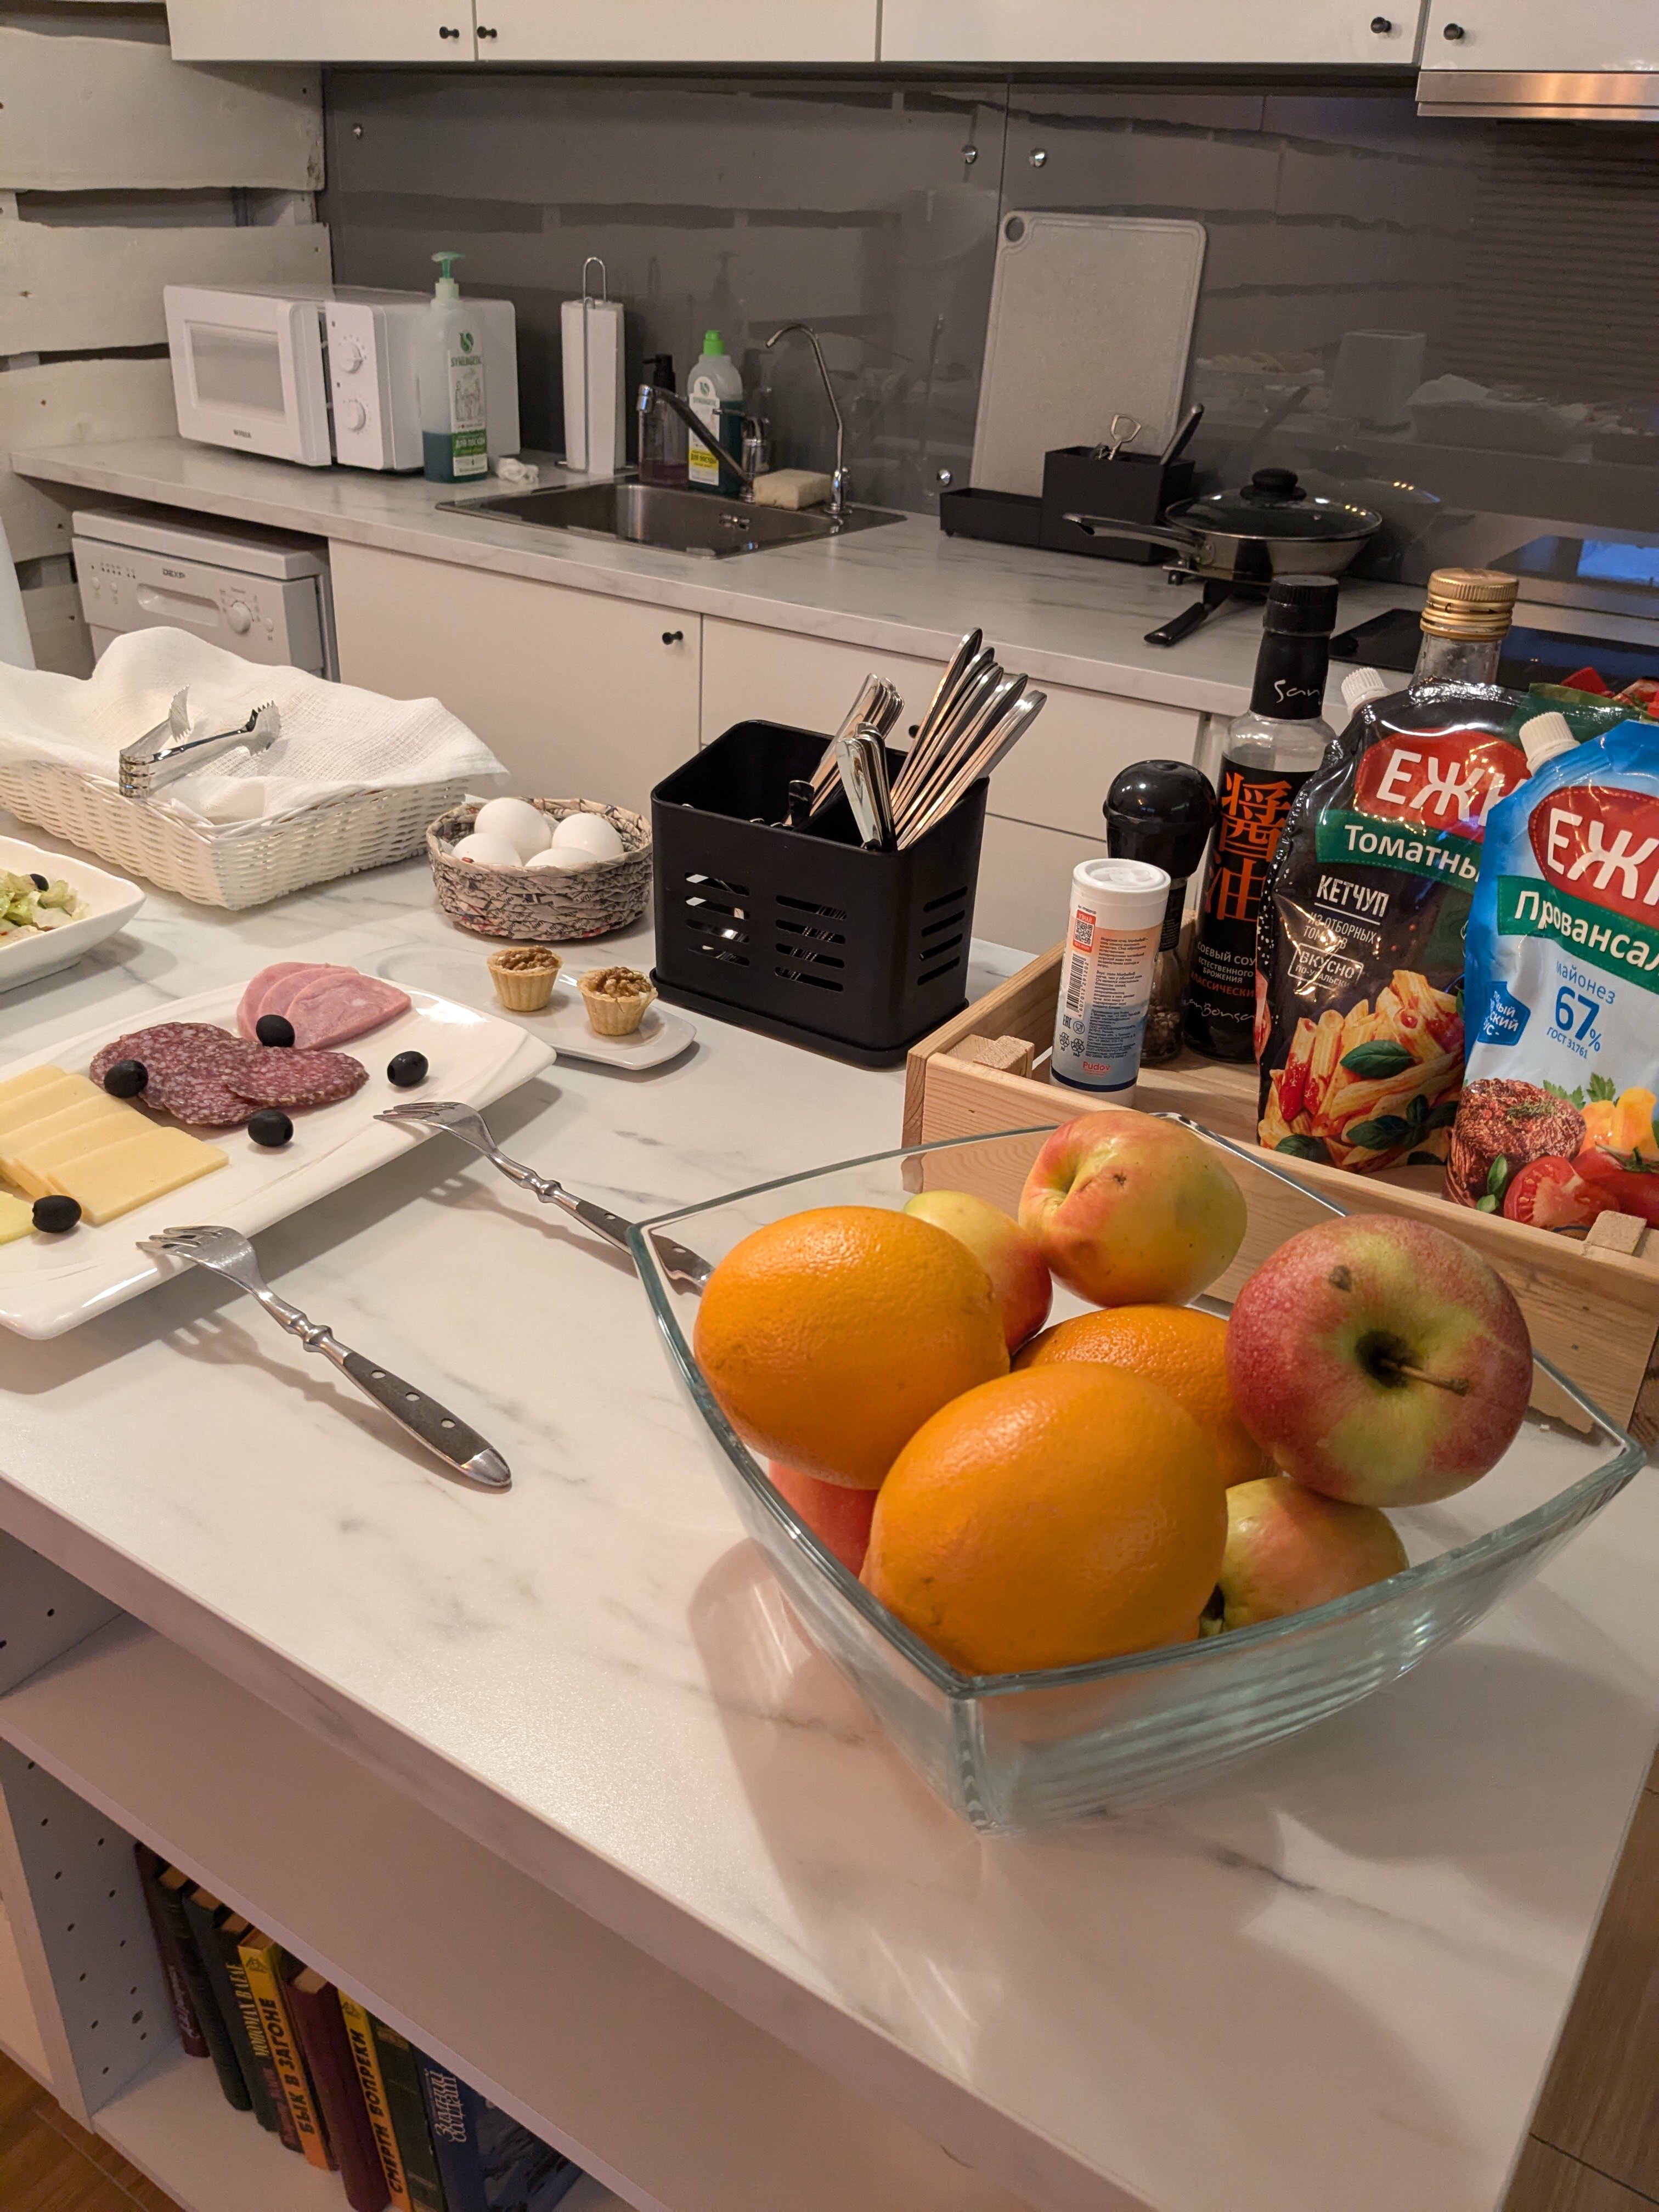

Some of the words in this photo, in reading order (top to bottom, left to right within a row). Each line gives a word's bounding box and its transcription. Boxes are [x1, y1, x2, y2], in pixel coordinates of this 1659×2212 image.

[1274, 679, 1322, 704] San
[1344, 825, 1480, 882] Томатны
[1317, 874, 1390, 917] КЕТЧУП
[1302, 925, 1348, 950] ТОМОВ
[1323, 917, 1377, 944] ОТБОРНЫХ
[1197, 941, 1232, 962] СОЕВЫЙ
[1234, 956, 1256, 966] СОУ
[1198, 956, 1254, 978] ЕСТЕСТВЕННОГО
[1300, 951, 1355, 979] ВКУСНО
[1190, 969, 1255, 997] КЛАССИЧЕСКИ
[1203, 967, 1243, 984] БРОЖЕНИЯ
[1547, 1026, 1567, 1045] ГОСТ
[1567, 1039, 1588, 1059] 31761
[1082, 1061, 1111, 1071] Pudov
[258, 1997, 295, 2070] ЗАГОНЕ
[284, 2074, 300, 2087] В
[349, 2028, 384, 2118] ВОПРЕКИ
[288, 2091, 315, 2135] БЫК
